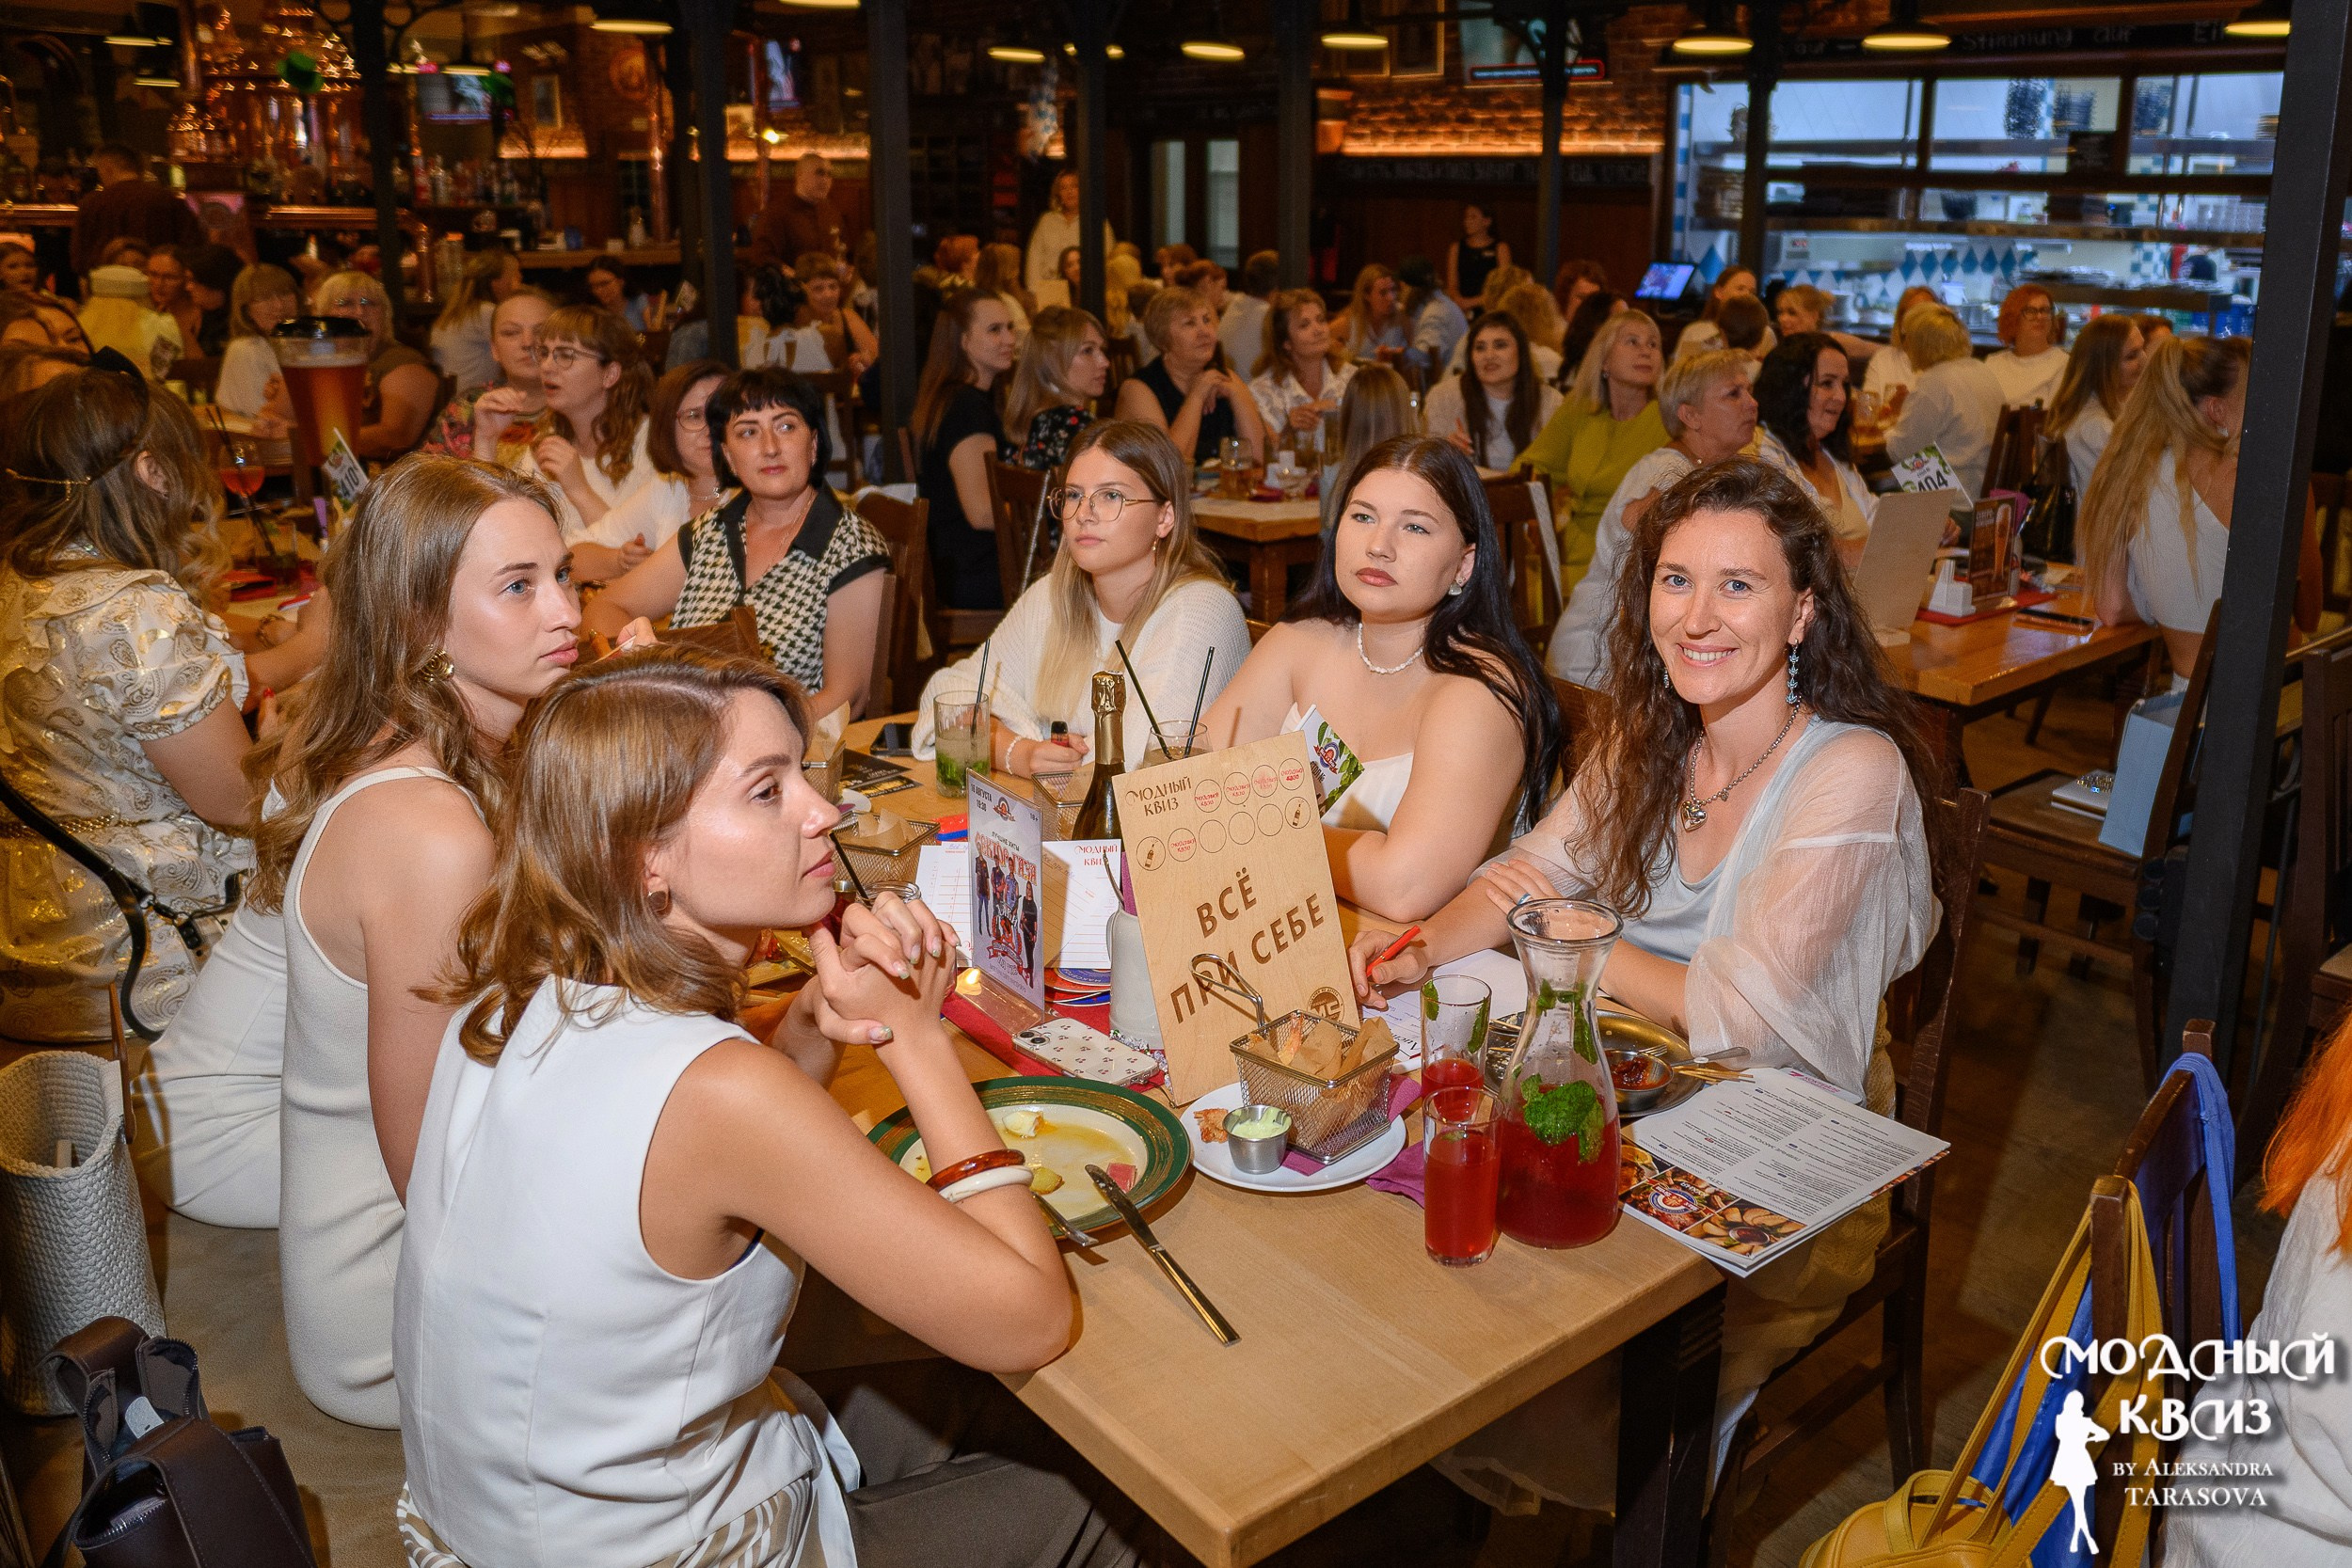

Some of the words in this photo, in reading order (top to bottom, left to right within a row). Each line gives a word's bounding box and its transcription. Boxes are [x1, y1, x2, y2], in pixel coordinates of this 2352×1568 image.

[1961, 26, 2074, 51] Stimmung
[976, 785, 993, 802] АВГУСТА
[1125, 776, 1193, 806] МОДНЫЙ
[1143, 798, 1179, 816] КВИЗ
[1074, 845, 1118, 854] МОДНЫЙ
[1196, 867, 1258, 939] ВСЁ
[1250, 894, 1325, 965] СЕБЕ
